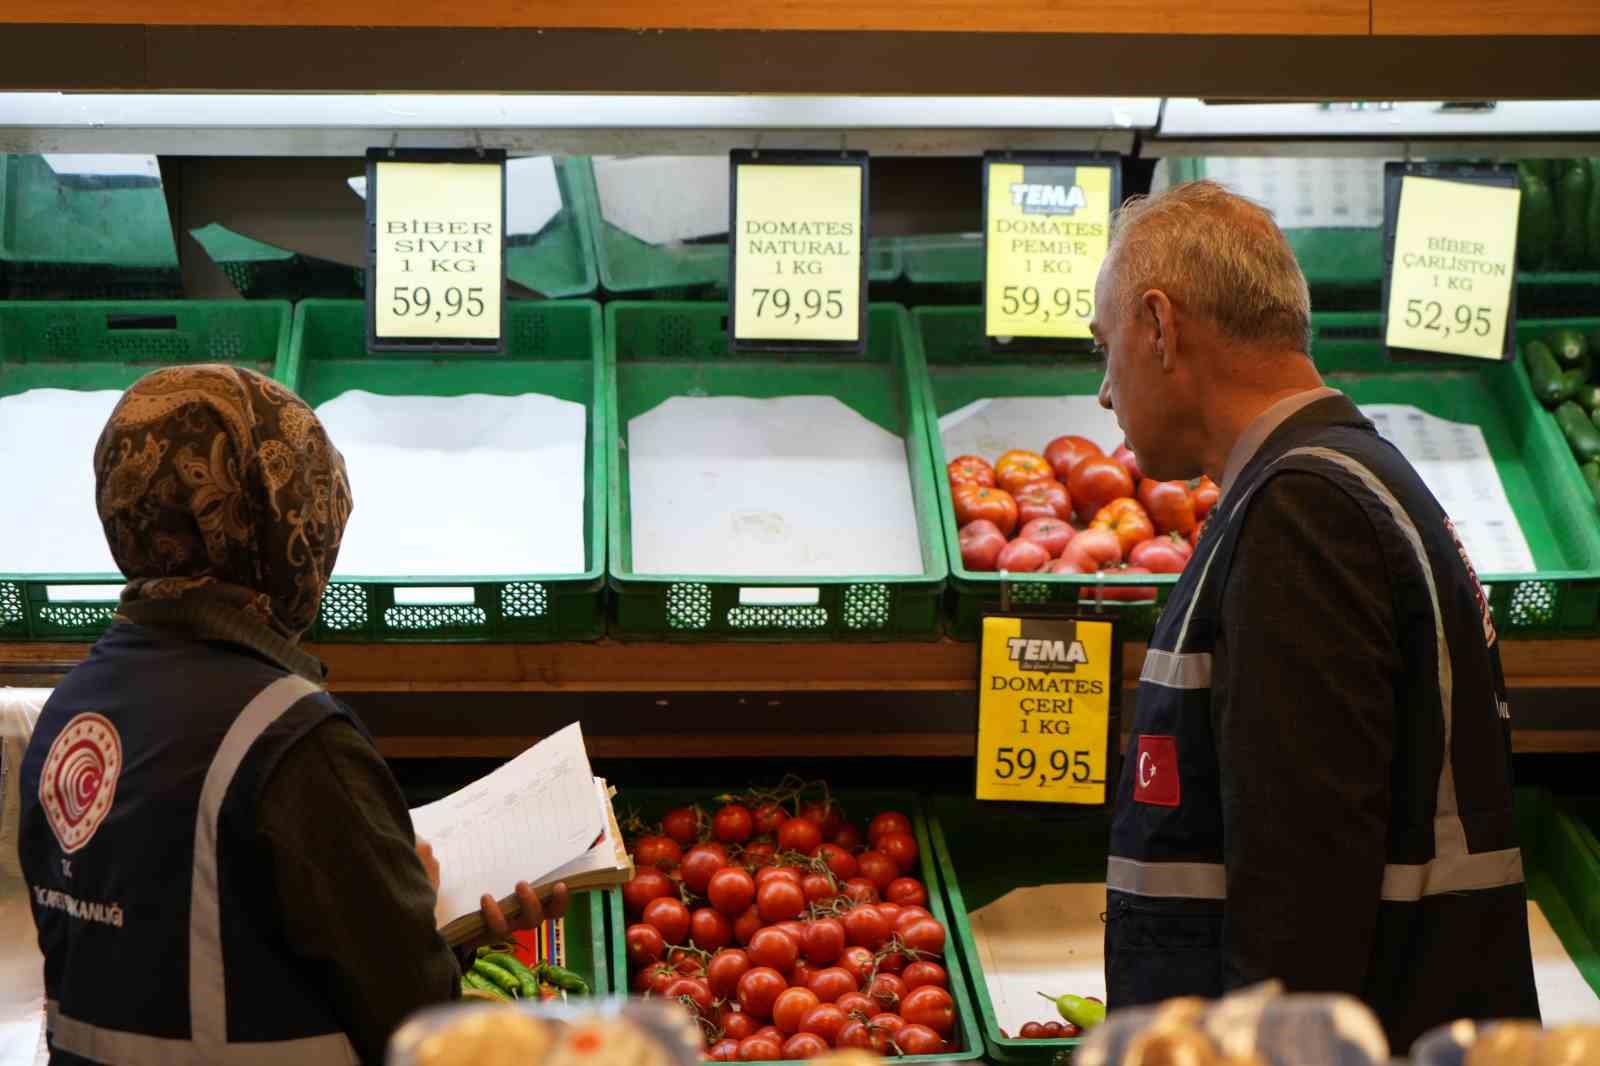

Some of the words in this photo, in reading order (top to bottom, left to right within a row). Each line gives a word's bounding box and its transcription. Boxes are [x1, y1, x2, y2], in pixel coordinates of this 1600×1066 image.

[1010, 184, 1085, 209] TEMA
[387, 220, 493, 235] BİBER
[746, 221, 853, 234] DOMATES
[996, 219, 1103, 236] DOMATES
[394, 239, 483, 254] SİVRİ
[747, 240, 850, 255] NATURAL
[1010, 240, 1087, 254] PEMBE
[1427, 236, 1486, 257] BİBER
[403, 259, 411, 272] 1
[430, 259, 477, 272] KG
[775, 260, 783, 274] 1
[792, 261, 823, 275] KG
[1026, 259, 1033, 273] 1
[1042, 260, 1072, 274] KG
[1432, 275, 1439, 288] 1
[1447, 276, 1474, 292] KG
[391, 286, 486, 322] 59,95
[752, 288, 844, 322] 79,95
[1001, 286, 1093, 323] 59,95
[1404, 299, 1491, 337] 52,95
[1009, 638, 1086, 663] TEMA
[992, 676, 1103, 694] DOMATES
[1020, 698, 1073, 715] ÇERİ
[1020, 719, 1028, 733] 1
[1040, 720, 1071, 734] KG
[995, 747, 1092, 786] 59,95
